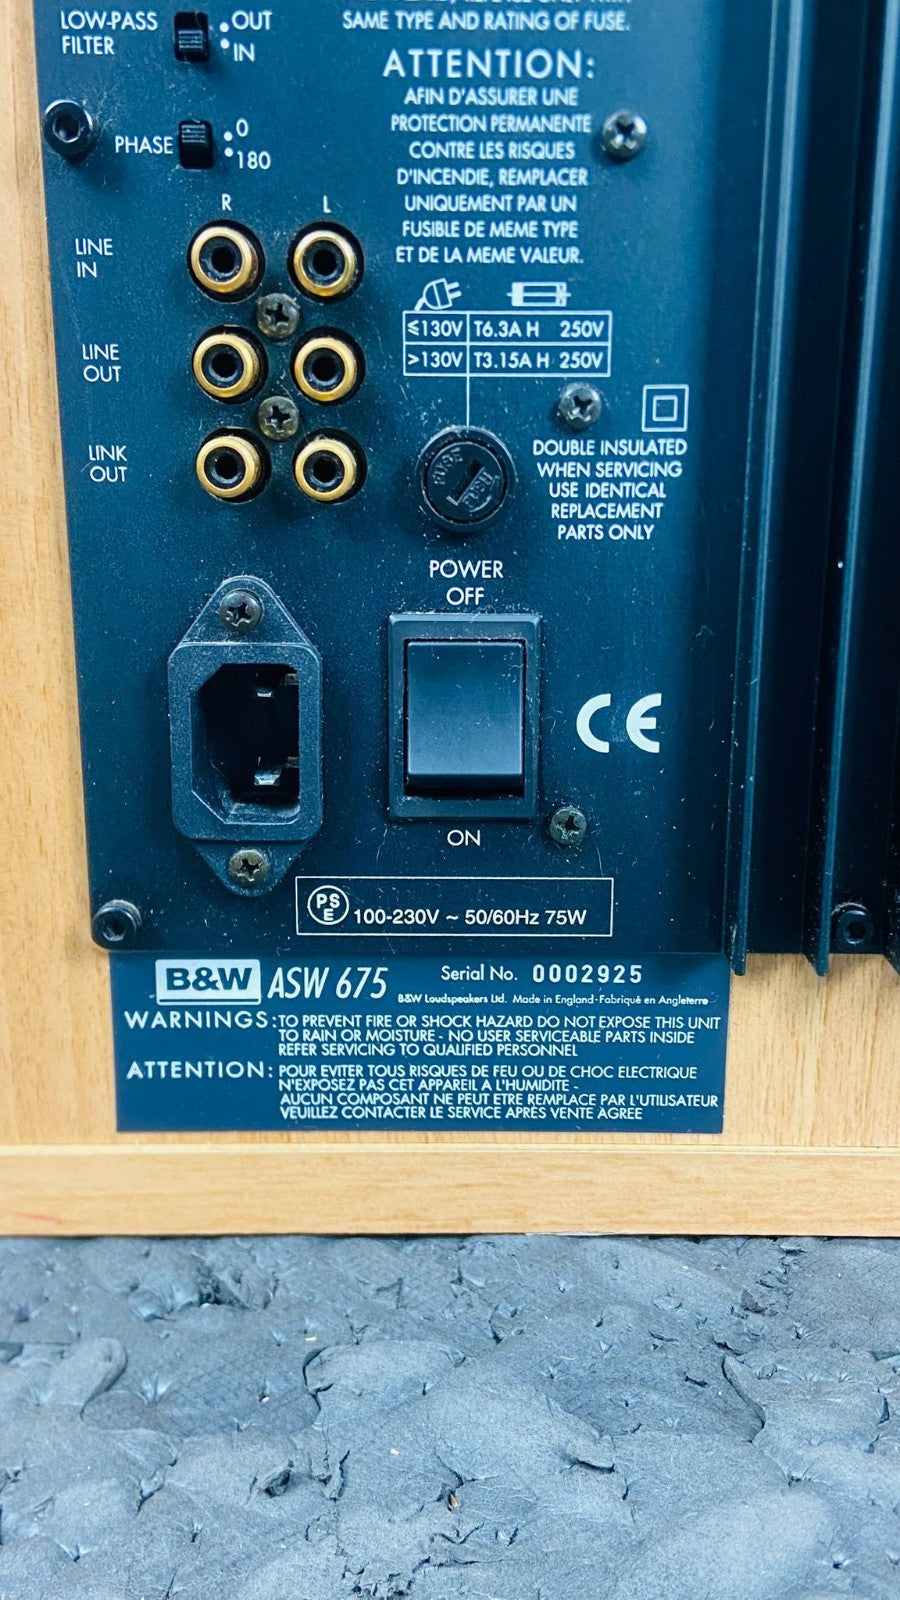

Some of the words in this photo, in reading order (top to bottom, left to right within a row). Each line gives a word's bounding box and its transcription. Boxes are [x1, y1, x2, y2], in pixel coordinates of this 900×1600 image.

[61, 10, 157, 30] LOW-PASS
[232, 10, 272, 30] OUT
[343, 11, 388, 29] SAME
[395, 11, 433, 30] TYPE
[438, 11, 479, 30] AND
[484, 11, 550, 30] RATING
[554, 11, 579, 30] OF
[584, 10, 629, 31] FUSE.
[62, 35, 114, 54] FILTER
[234, 43, 254, 61] IN
[383, 49, 594, 78] ATTENTION:
[404, 87, 444, 104] AFIN
[449, 87, 537, 105] D'ASSURER
[542, 87, 578, 106] UNE
[236, 119, 248, 137] 0
[391, 114, 487, 132] PROTECTION
[491, 114, 591, 133] PERMANENTE
[115, 136, 173, 154] PHASE
[409, 141, 474, 159] CONTRE
[480, 141, 504, 159] LES
[509, 141, 575, 159] RISQUES
[238, 151, 271, 169] 180
[397, 168, 493, 188] D'INCENDIE,
[499, 168, 588, 186] REMPLACER
[222, 194, 231, 211] R
[323, 196, 331, 213] L
[405, 194, 513, 212] UNIQUEMENT
[517, 195, 546, 212] PAR
[551, 195, 577, 212] UN
[403, 220, 459, 237] FUSIBLE
[465, 221, 485, 237] DE
[489, 221, 538, 238] MEME
[542, 221, 578, 238] TYPE
[75, 238, 113, 255] LINE
[396, 246, 414, 262] ET
[419, 246, 438, 263] DE
[444, 247, 463, 263] LA
[467, 246, 515, 263] MEME
[520, 247, 583, 263] VALEUR.
[77, 261, 97, 278] IN
[474, 321, 521, 337] T6.3A
[527, 321, 539, 337] H
[560, 320, 604, 337] 250V
[83, 344, 119, 360] LINE
[474, 352, 532, 368] T3.15A
[537, 352, 549, 368] H
[560, 352, 603, 368] 250V
[84, 365, 121, 382] OUT
[89, 445, 127, 461] LINK
[533, 439, 595, 456] DOUBLE
[601, 438, 687, 455] INSULATED
[90, 465, 128, 483] OUT
[537, 462, 590, 477] WHEN
[595, 461, 682, 477] SERVICING
[549, 482, 578, 498] USE
[586, 482, 666, 498] IDENTICAL
[552, 503, 663, 519] REPLACEMENT
[558, 524, 604, 540] PARTS
[609, 524, 654, 540] ONLY
[429, 560, 503, 578] POWER
[446, 587, 484, 605] OFF
[447, 830, 480, 846] ON
[354, 909, 439, 926] 100-230V
[465, 909, 539, 925] 50/60Hz
[545, 910, 586, 925] 75W
[441, 964, 484, 980] Serial
[490, 966, 517, 980] No.
[533, 964, 641, 983] 0002925
[165, 967, 253, 991] B&W
[267, 967, 329, 998] ASW
[336, 967, 388, 998] 675
[398, 994, 422, 1003] B&W
[425, 993, 488, 1005] Loudspeakers
[491, 993, 507, 1003] Ltd.
[513, 994, 540, 1003] Made
[544, 995, 552, 1003] in
[659, 994, 708, 1007] Angleterre
[278, 1015, 298, 1028] TO
[303, 1015, 362, 1028] PREVENT
[366, 1015, 392, 1028] FIRE
[396, 1015, 416, 1028] OR
[422, 1015, 472, 1027] SHOCK
[476, 1015, 533, 1027] HAZARD
[538, 1016, 560, 1028] DO
[564, 1016, 596, 1028] NOT
[599, 1016, 651, 1028] EXPOSE
[655, 1017, 684, 1028] THIS
[688, 1017, 721, 1029] UNIT
[279, 1030, 299, 1042] TO
[302, 1030, 336, 1042] RAIN
[340, 1030, 362, 1042] OR
[365, 1030, 436, 1042] MOISTURE
[449, 1030, 473, 1042] NO
[478, 1030, 511, 1042] USER
[516, 1030, 600, 1043] SERVICEABLE
[606, 1031, 645, 1043] PARTS
[650, 1031, 694, 1043] INSIDE
[279, 1043, 317, 1056] REFER
[322, 1043, 395, 1056] SERVICING
[399, 1043, 419, 1056] TO
[423, 1044, 493, 1056] QUALIFIED
[497, 1044, 578, 1056] PERSONNEL
[127, 1061, 272, 1079] ATTENTION:
[279, 1065, 316, 1077] POUR
[321, 1065, 363, 1079] EVITER
[368, 1065, 405, 1077] TOUS
[410, 1065, 467, 1077] RISQUES
[472, 1065, 488, 1077] DE
[493, 1065, 517, 1077] FEU
[522, 1065, 544, 1077] OU
[549, 1066, 566, 1077] DE
[570, 1066, 614, 1078] CHOC
[618, 1066, 697, 1079] ELECTRIQUE
[279, 1079, 355, 1091] N'EXPOSEZ
[360, 1079, 385, 1091] PAS
[389, 1079, 414, 1091] CET
[418, 1079, 478, 1091] APPAREIL
[481, 1079, 492, 1091] A
[496, 1079, 569, 1091] L'HUMIDITE
[280, 1093, 333, 1106] AUCUN
[336, 1093, 430, 1106] COMPOSANT
[434, 1093, 453, 1106] NE
[458, 1093, 491, 1106] PEUT
[494, 1093, 522, 1105] ETRE
[528, 1094, 596, 1106] REMPLACE
[601, 1094, 625, 1105] PAR
[630, 1095, 718, 1106] L'UTILISATEUR
[280, 1106, 338, 1119] VEUILLEZ
[342, 1106, 426, 1119] CONTACTER
[430, 1106, 443, 1118] LE
[448, 1106, 501, 1118] SERVICE
[551, 1107, 593, 1119] VENTE
